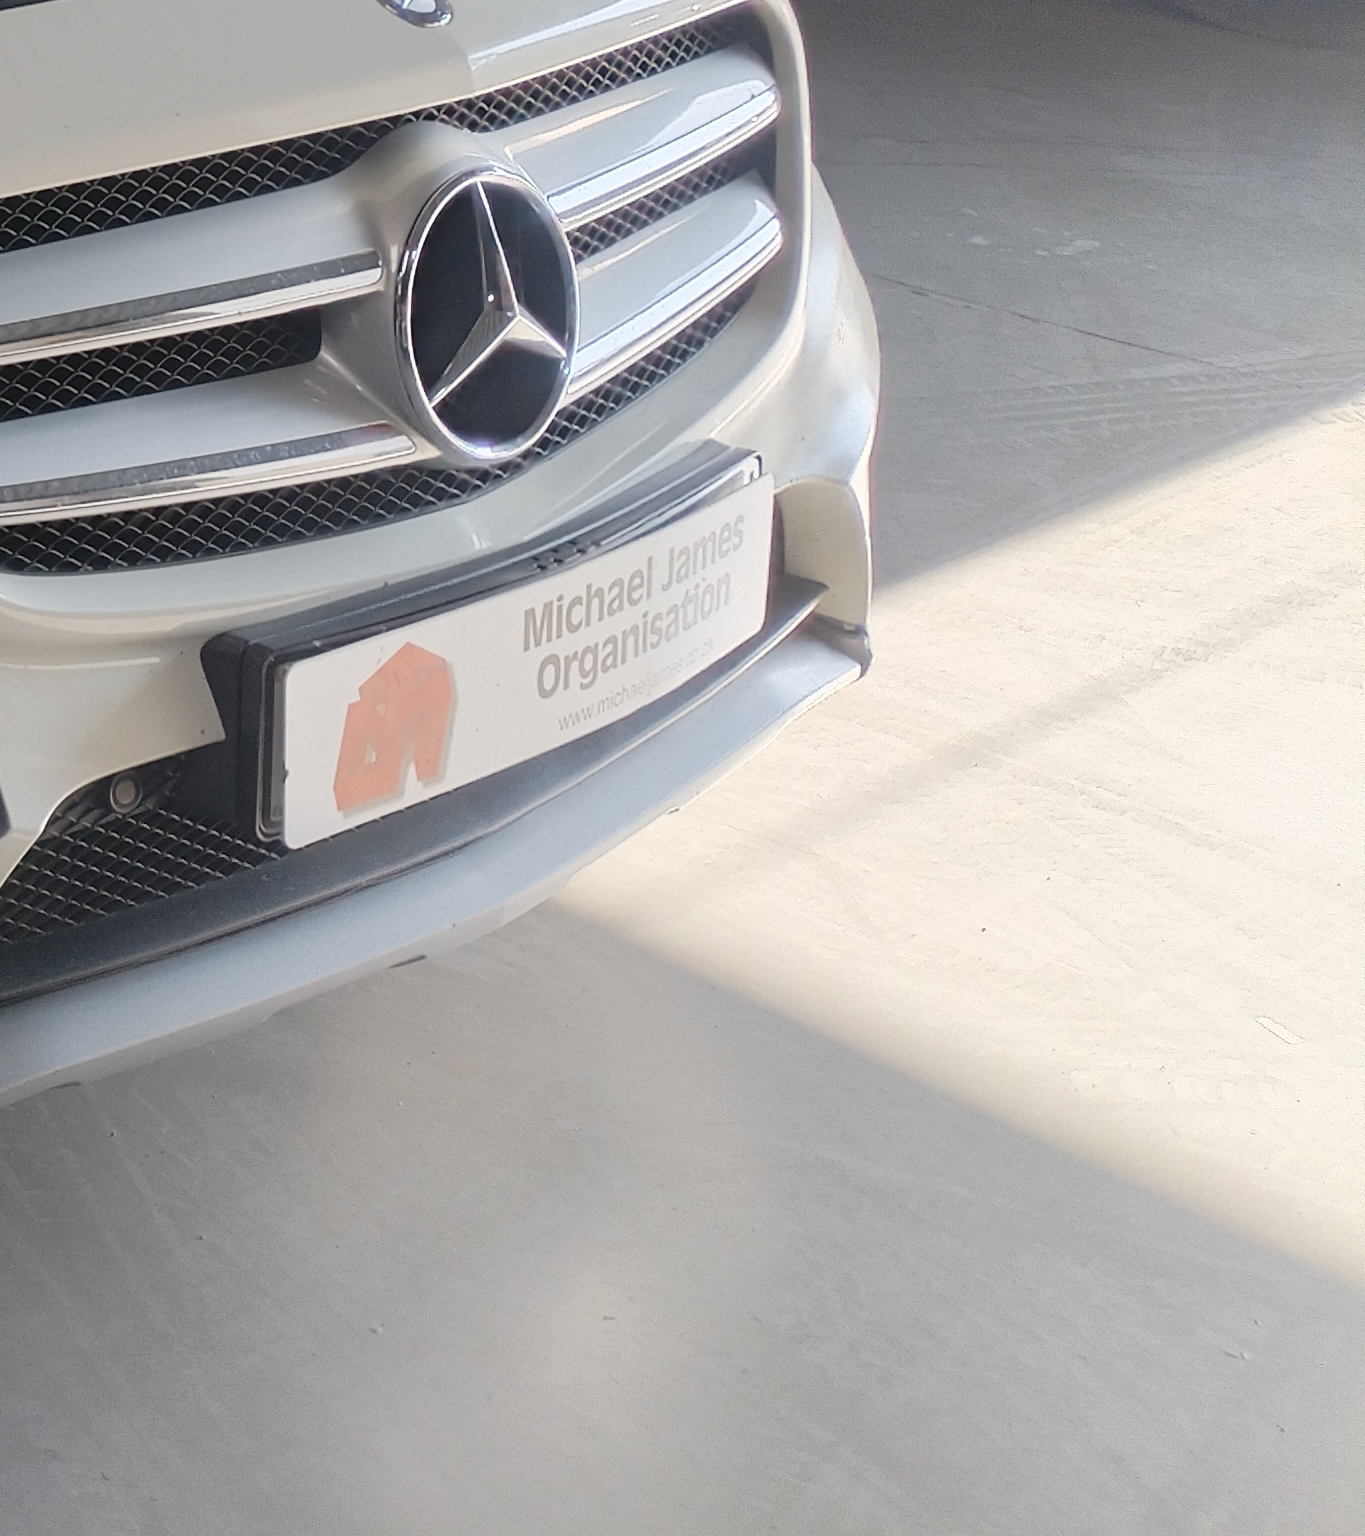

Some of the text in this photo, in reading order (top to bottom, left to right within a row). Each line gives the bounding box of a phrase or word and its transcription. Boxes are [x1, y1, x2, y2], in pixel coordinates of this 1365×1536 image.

[521, 512, 746, 653] Michael James
[535, 570, 732, 700] Organisation
